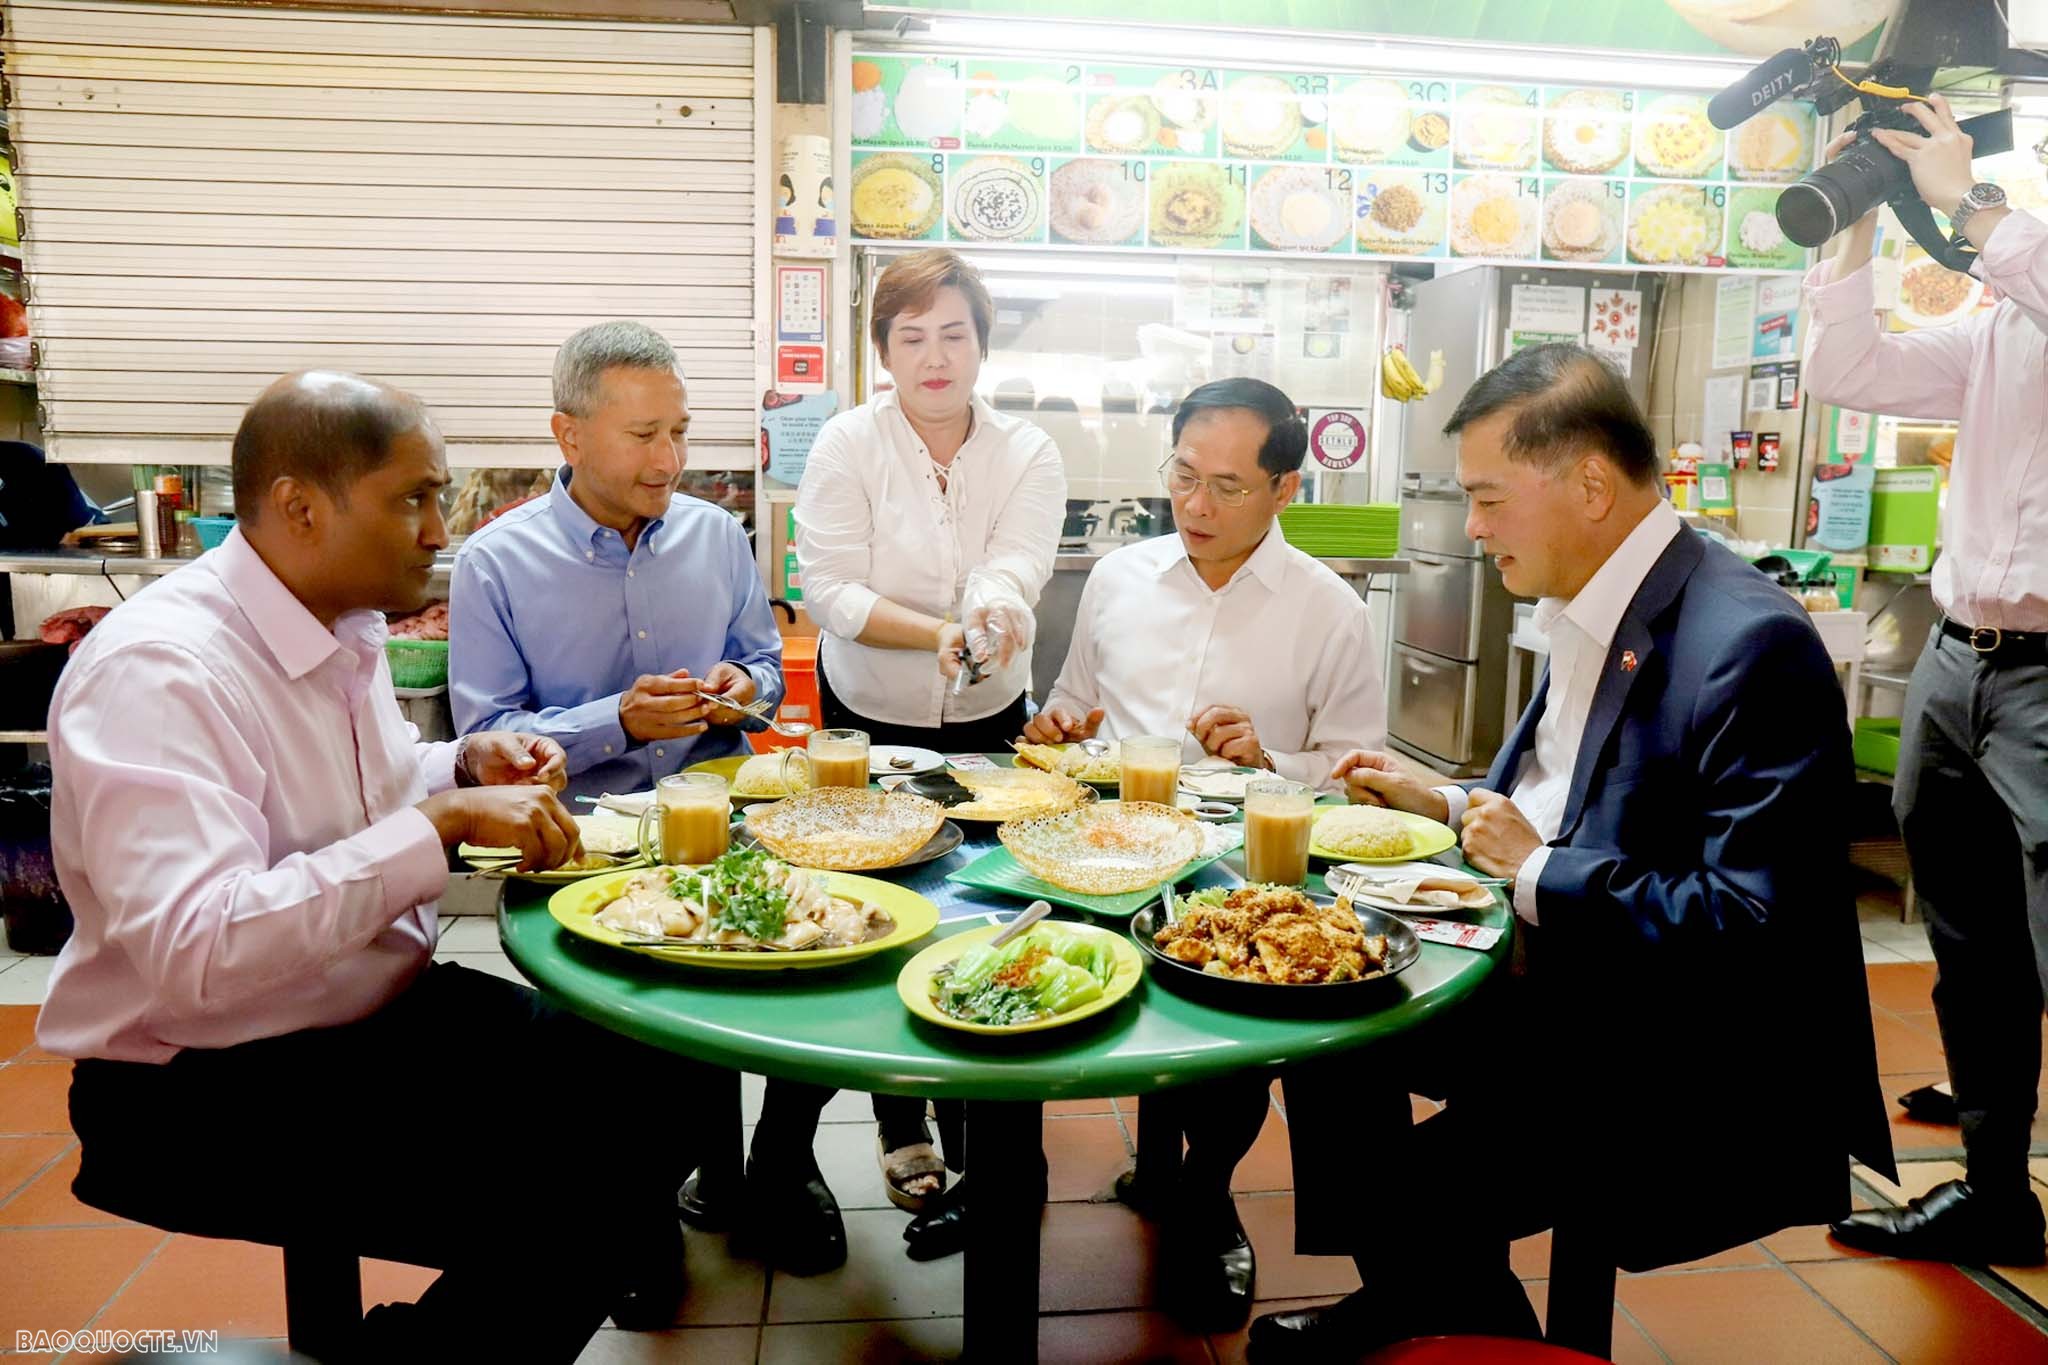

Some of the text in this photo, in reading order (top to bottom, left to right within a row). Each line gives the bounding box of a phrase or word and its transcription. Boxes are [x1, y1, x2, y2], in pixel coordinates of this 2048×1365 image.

[949, 60, 959, 80] 1
[1066, 64, 1081, 85] 2
[1179, 68, 1219, 91] 3A
[1409, 81, 1447, 103] 3C
[1751, 68, 1794, 106] DEITY
[1525, 88, 1539, 109] 4
[1623, 91, 1634, 112] 5
[931, 153, 944, 174] 8
[1030, 156, 1045, 178] 9
[1120, 159, 1146, 182] 10
[1224, 163, 1247, 186] 11
[1324, 167, 1352, 191] 12
[1422, 172, 1449, 194] 13
[1515, 177, 1540, 199] 14
[1604, 180, 1626, 199] 15
[1700, 184, 1726, 208] 16
